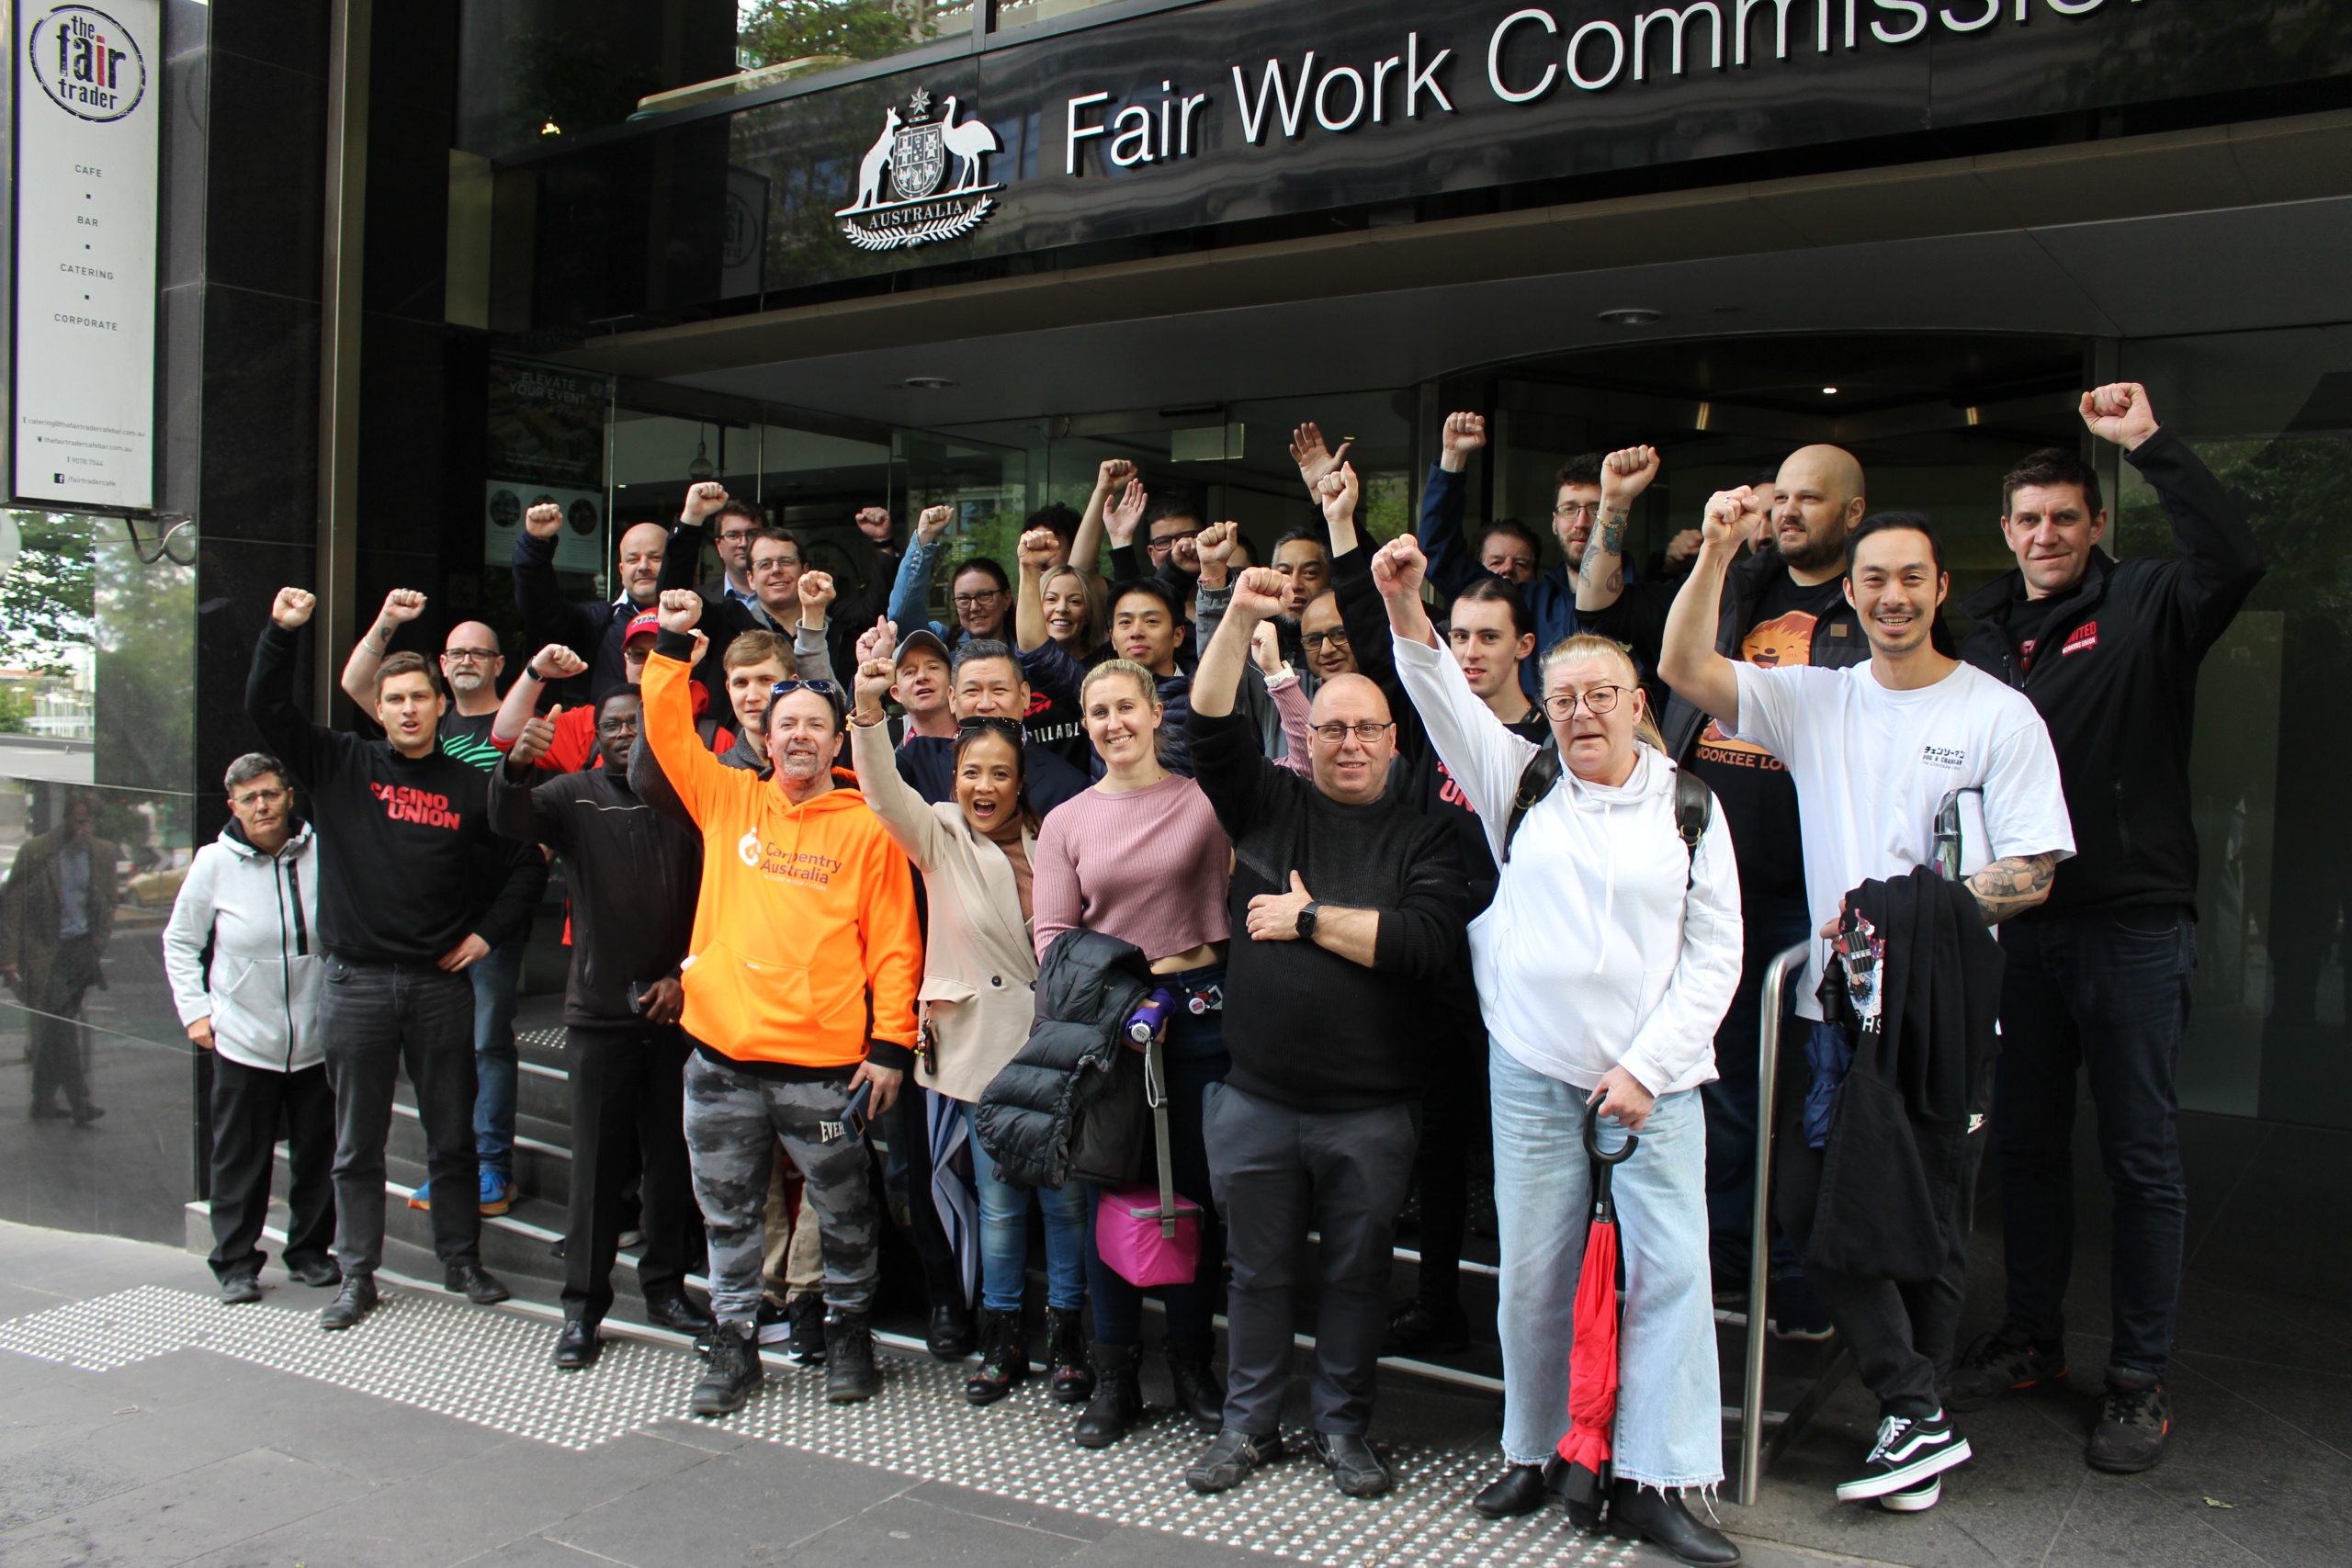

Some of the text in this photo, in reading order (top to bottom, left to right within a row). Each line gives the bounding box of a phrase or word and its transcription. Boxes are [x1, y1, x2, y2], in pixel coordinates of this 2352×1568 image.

[71, 16, 95, 39] the
[56, 23, 127, 89] fair
[58, 78, 119, 109] trader
[1066, 79, 1205, 175] Fair
[1232, 31, 1453, 143] Work
[74, 164, 103, 178] CAFE
[77, 215, 99, 228] BAR
[868, 199, 964, 230] AUSTRALIA
[60, 263, 114, 280] CATERING
[54, 313, 119, 332] CORPORATE
[521, 372, 577, 391] ELEVATE
[509, 382, 588, 405] YOUR EVENT
[2064, 621, 2097, 645] NITED
[1027, 722, 1080, 744] ILLABL
[370, 782, 448, 811] CASINO
[388, 801, 460, 830] UNION
[765, 841, 842, 874] Carpentry
[761, 859, 829, 884] Australia
[1969, 1113, 1984, 1127] IKE
[819, 1121, 846, 1144] EVER
